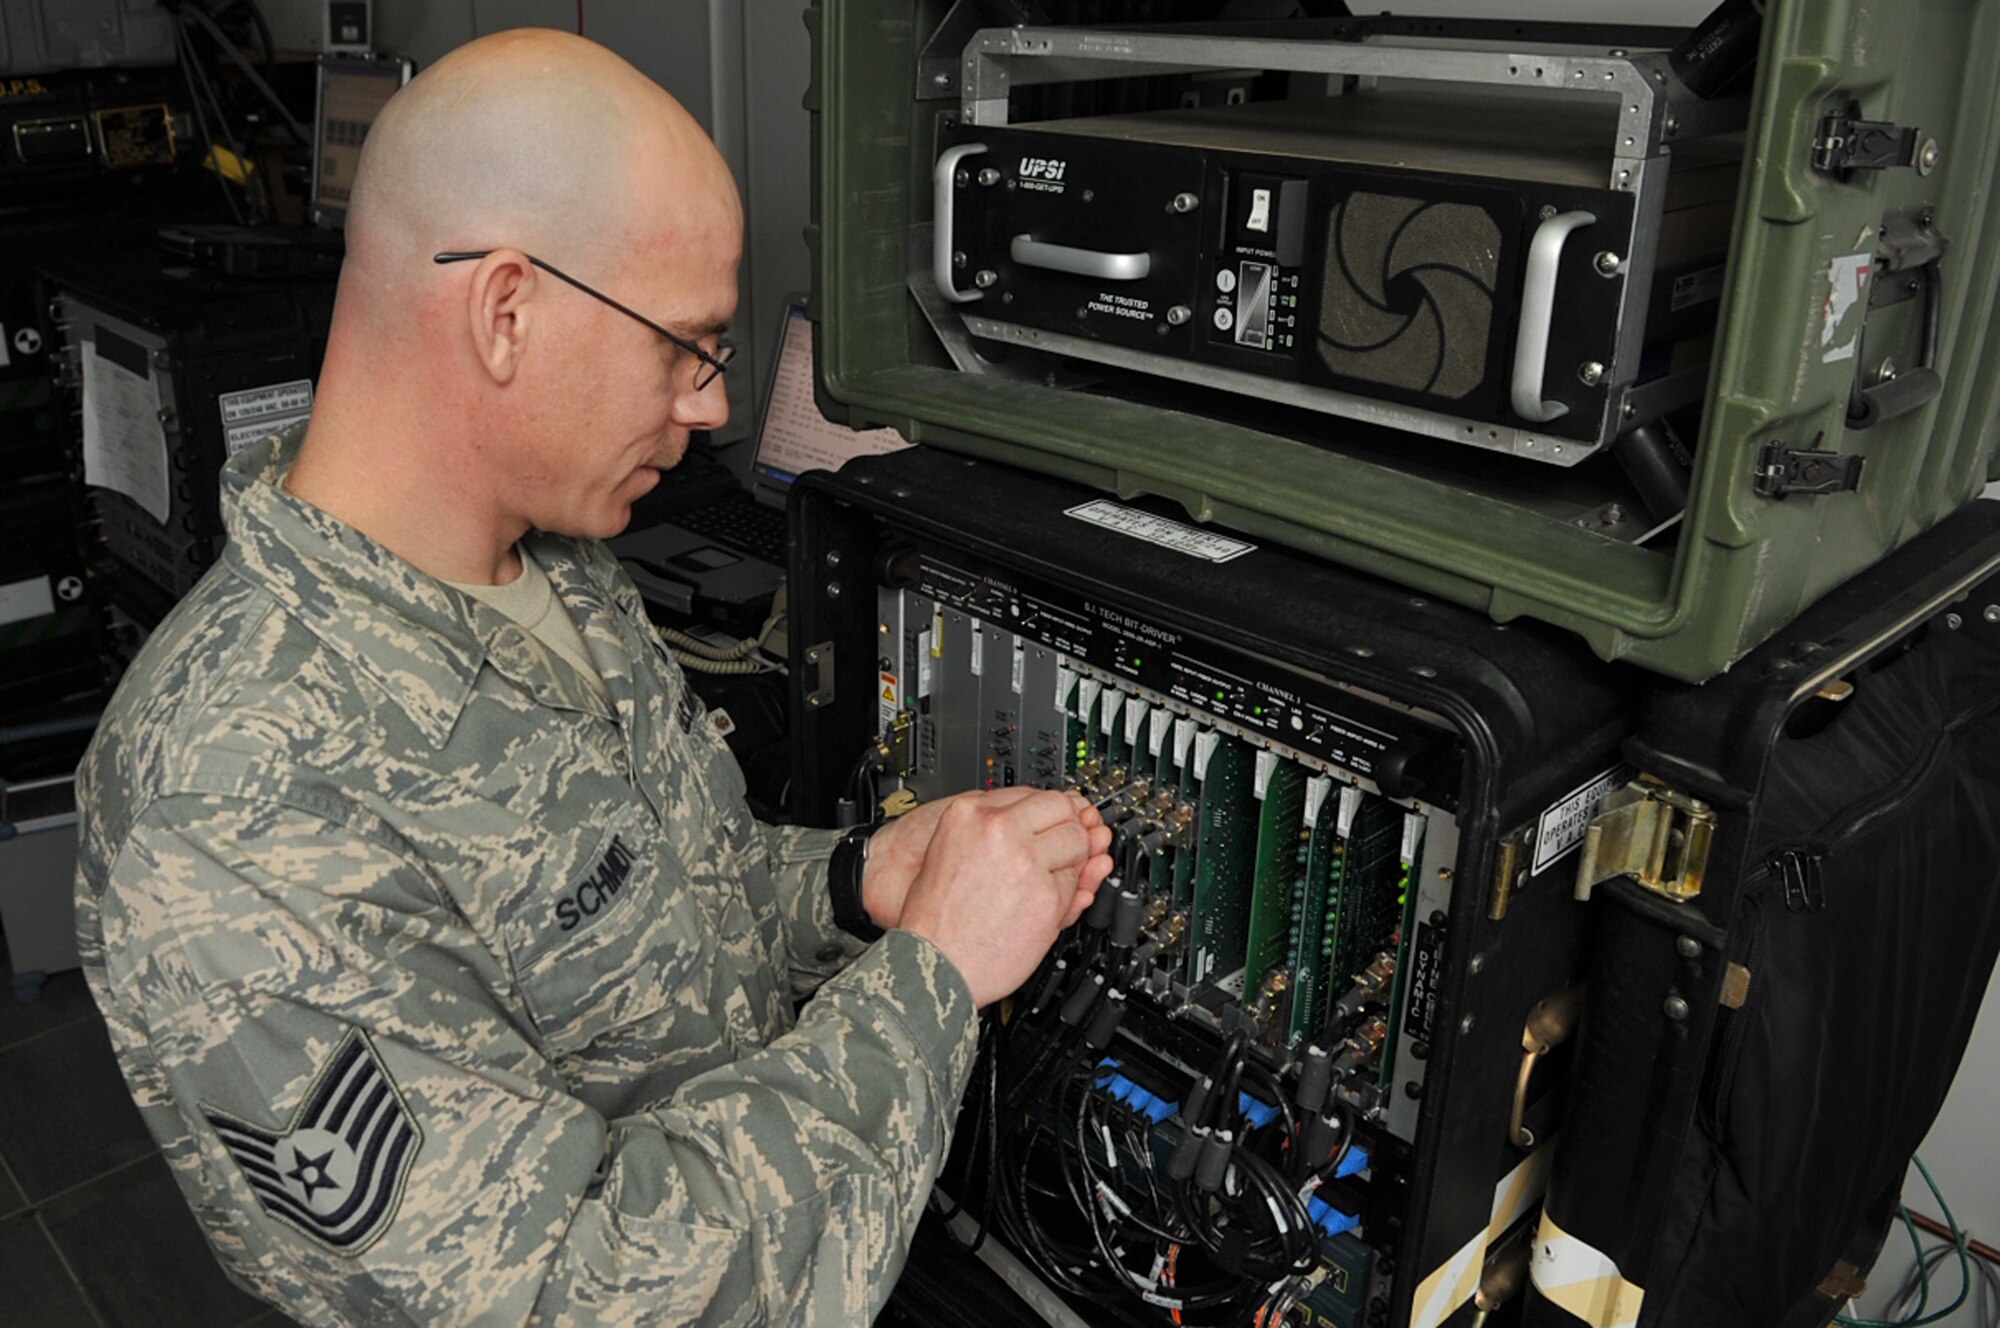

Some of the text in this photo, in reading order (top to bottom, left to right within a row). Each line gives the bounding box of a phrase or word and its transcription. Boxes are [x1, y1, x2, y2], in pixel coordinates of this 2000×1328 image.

[1087, 301, 1115, 314] POWER
[1100, 292, 1115, 303] THE
[1100, 607, 1123, 624] TECH
[1256, 681, 1295, 703] CHANNEL
[1560, 798, 1580, 820] THIS
[1544, 806, 1589, 846] OPERATES
[555, 833, 637, 931] SCHMIDT
[1411, 950, 1429, 1018] DYNAMIC
